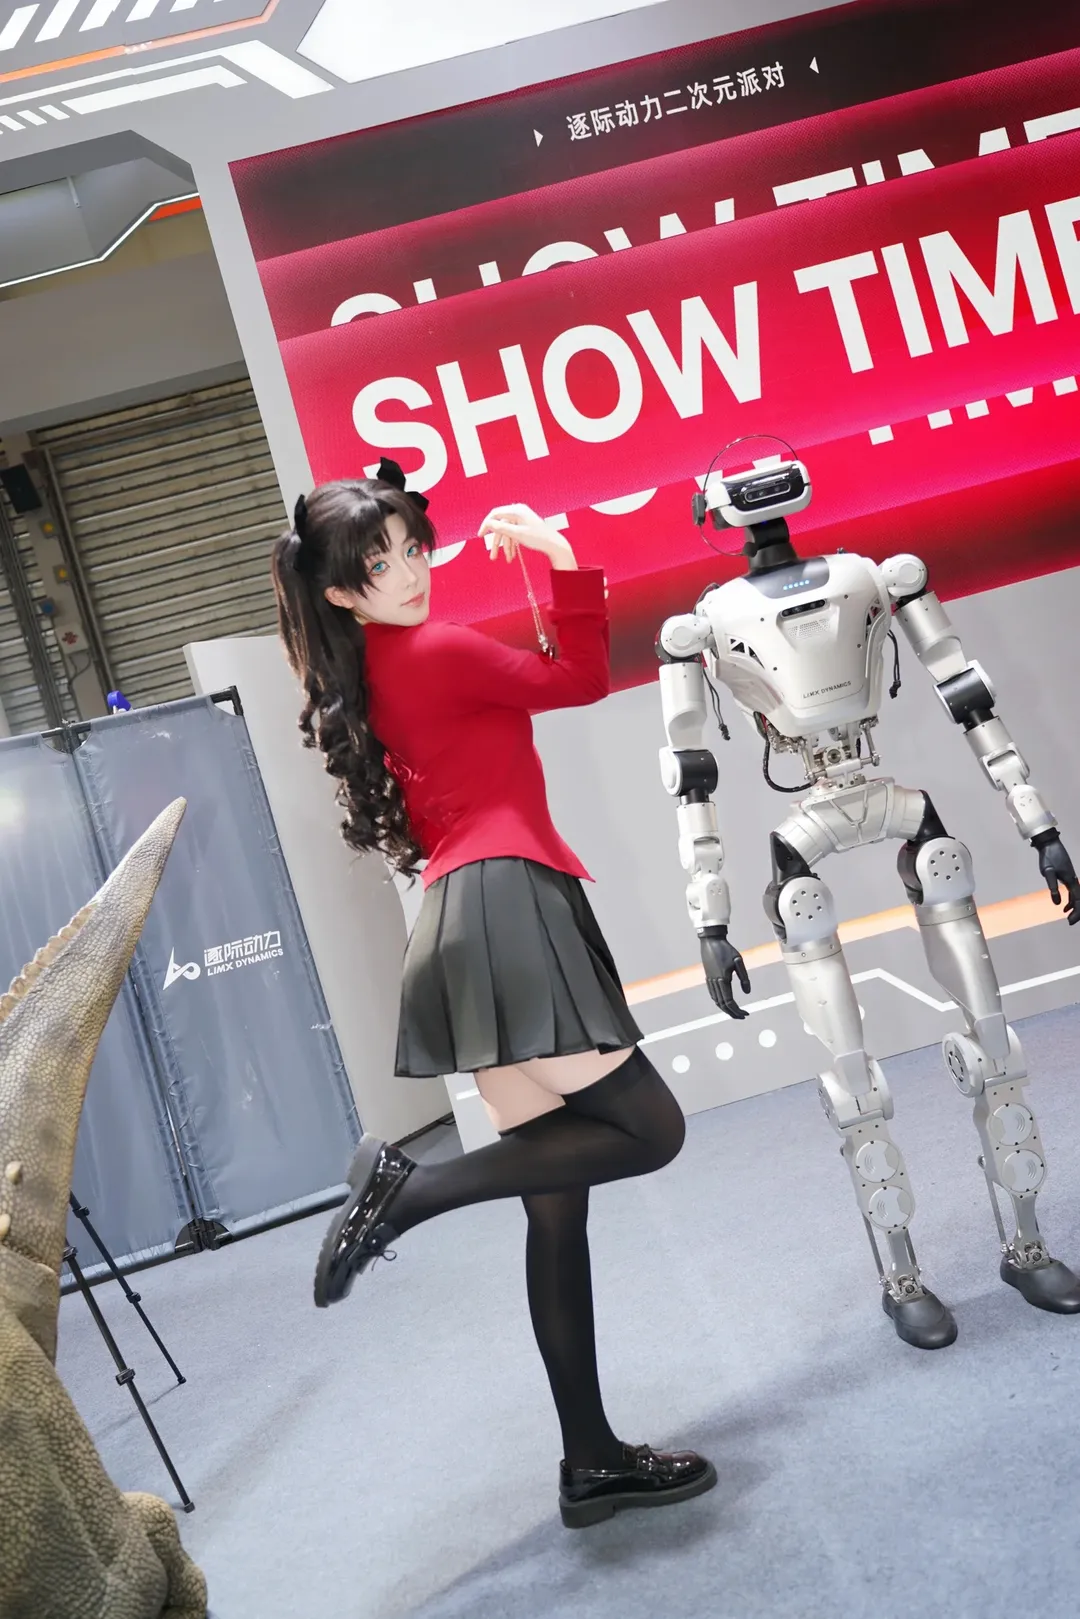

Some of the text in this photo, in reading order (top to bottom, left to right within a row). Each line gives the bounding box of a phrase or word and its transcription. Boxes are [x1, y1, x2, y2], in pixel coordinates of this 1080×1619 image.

[566, 61, 785, 142] 逐际动力二次元派对
[351, 280, 761, 494] SHOW
[803, 680, 852, 699] LIMX DYNAMICS
[203, 930, 282, 967] 逐际动力
[207, 948, 284, 977] LIMX DYNAMICS
